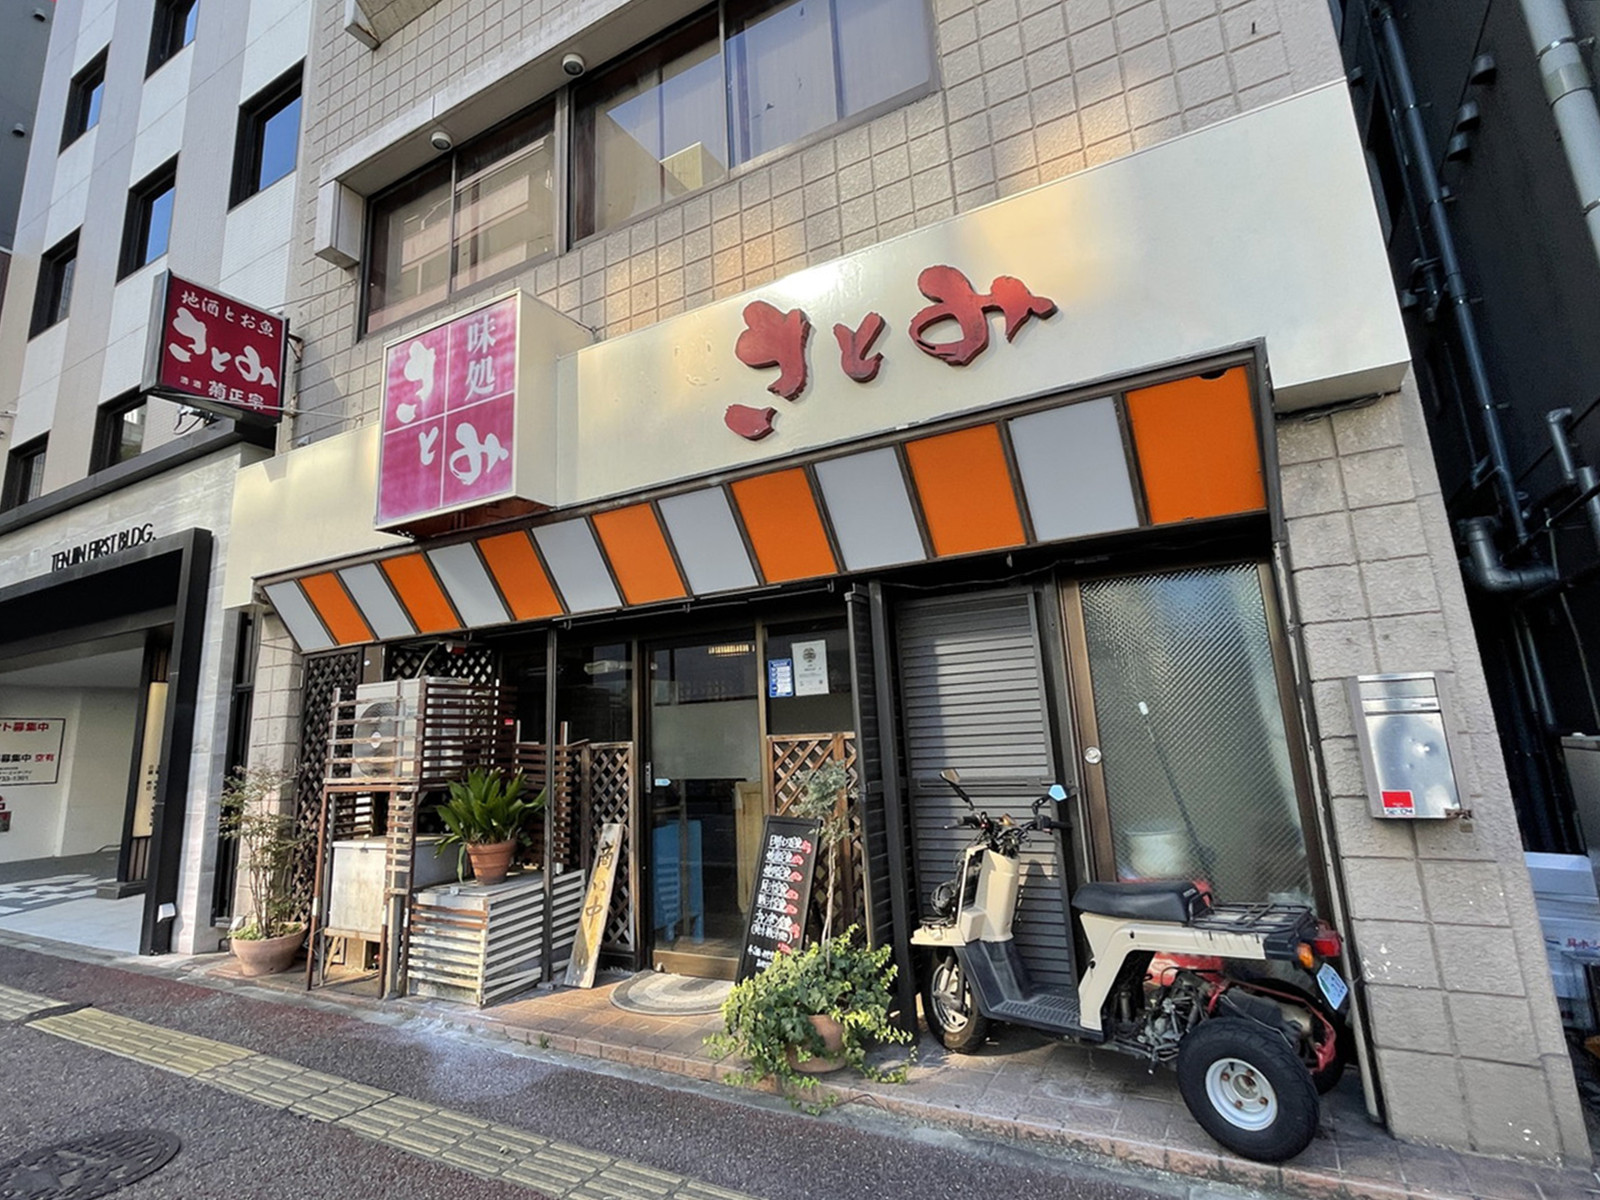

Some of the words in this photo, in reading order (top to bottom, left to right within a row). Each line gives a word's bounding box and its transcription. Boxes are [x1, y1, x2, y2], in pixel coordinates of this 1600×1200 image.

[181, 290, 275, 338] 地酒とお魚
[168, 307, 277, 388] さとみ
[465, 314, 496, 401] 味処
[724, 264, 1058, 441] さとみ
[52, 543, 87, 572] TENJIN
[88, 533, 118, 560] FIRST
[118, 523, 156, 551] BLDG.
[0, 721, 49, 732] ト募集中
[0, 753, 32, 763] 募集中
[585, 841, 614, 930] 商い中
